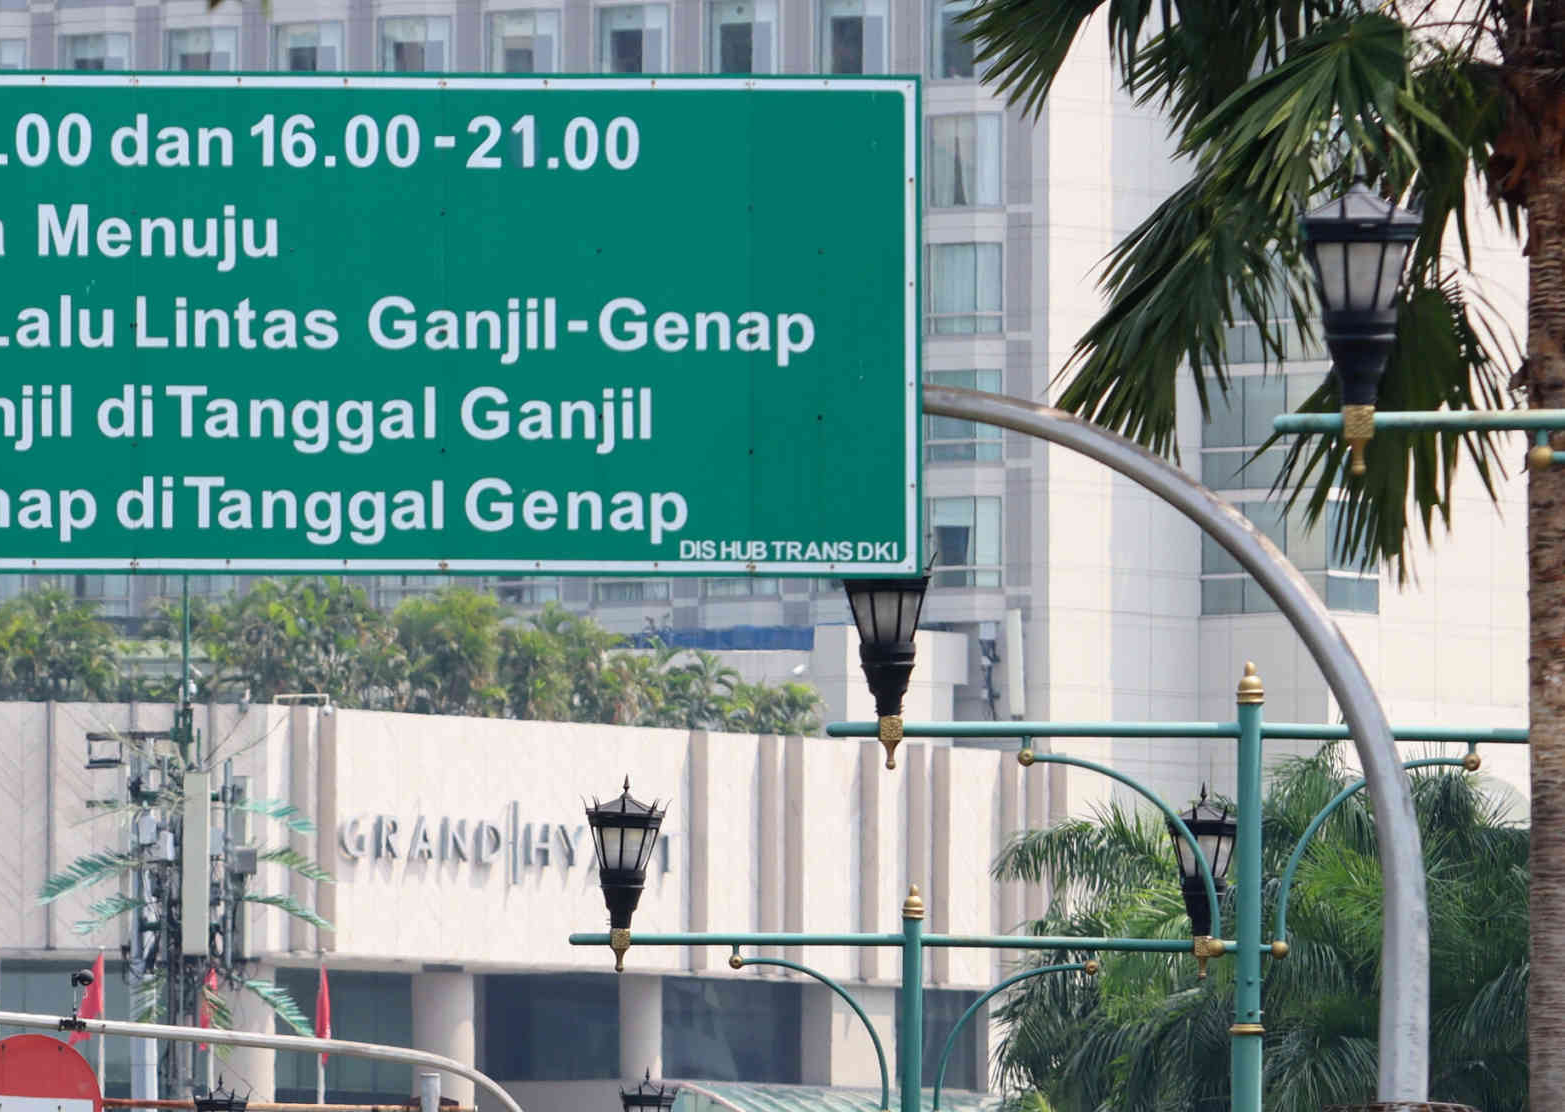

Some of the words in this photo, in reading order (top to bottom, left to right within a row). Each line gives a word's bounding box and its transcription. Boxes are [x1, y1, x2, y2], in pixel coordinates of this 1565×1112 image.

[111, 114, 232, 166] dan
[251, 114, 419, 167] 16.00
[466, 115, 639, 170] 21.00
[38, 204, 277, 271] Menuju
[136, 296, 338, 349] Lintas
[369, 296, 814, 366] Ganjil-Genap
[98, 384, 152, 437] di
[166, 386, 435, 453] Tanggal
[461, 387, 651, 454] Ganjil
[117, 476, 173, 529] di
[184, 477, 443, 544] Tanggal
[465, 478, 687, 543] Genap
[680, 540, 717, 560] DIS
[721, 540, 767, 561] HUB
[771, 540, 852, 562] TRANS
[857, 540, 898, 562] DKI
[339, 814, 501, 867] GRAND
[522, 824, 677, 874] HYT
